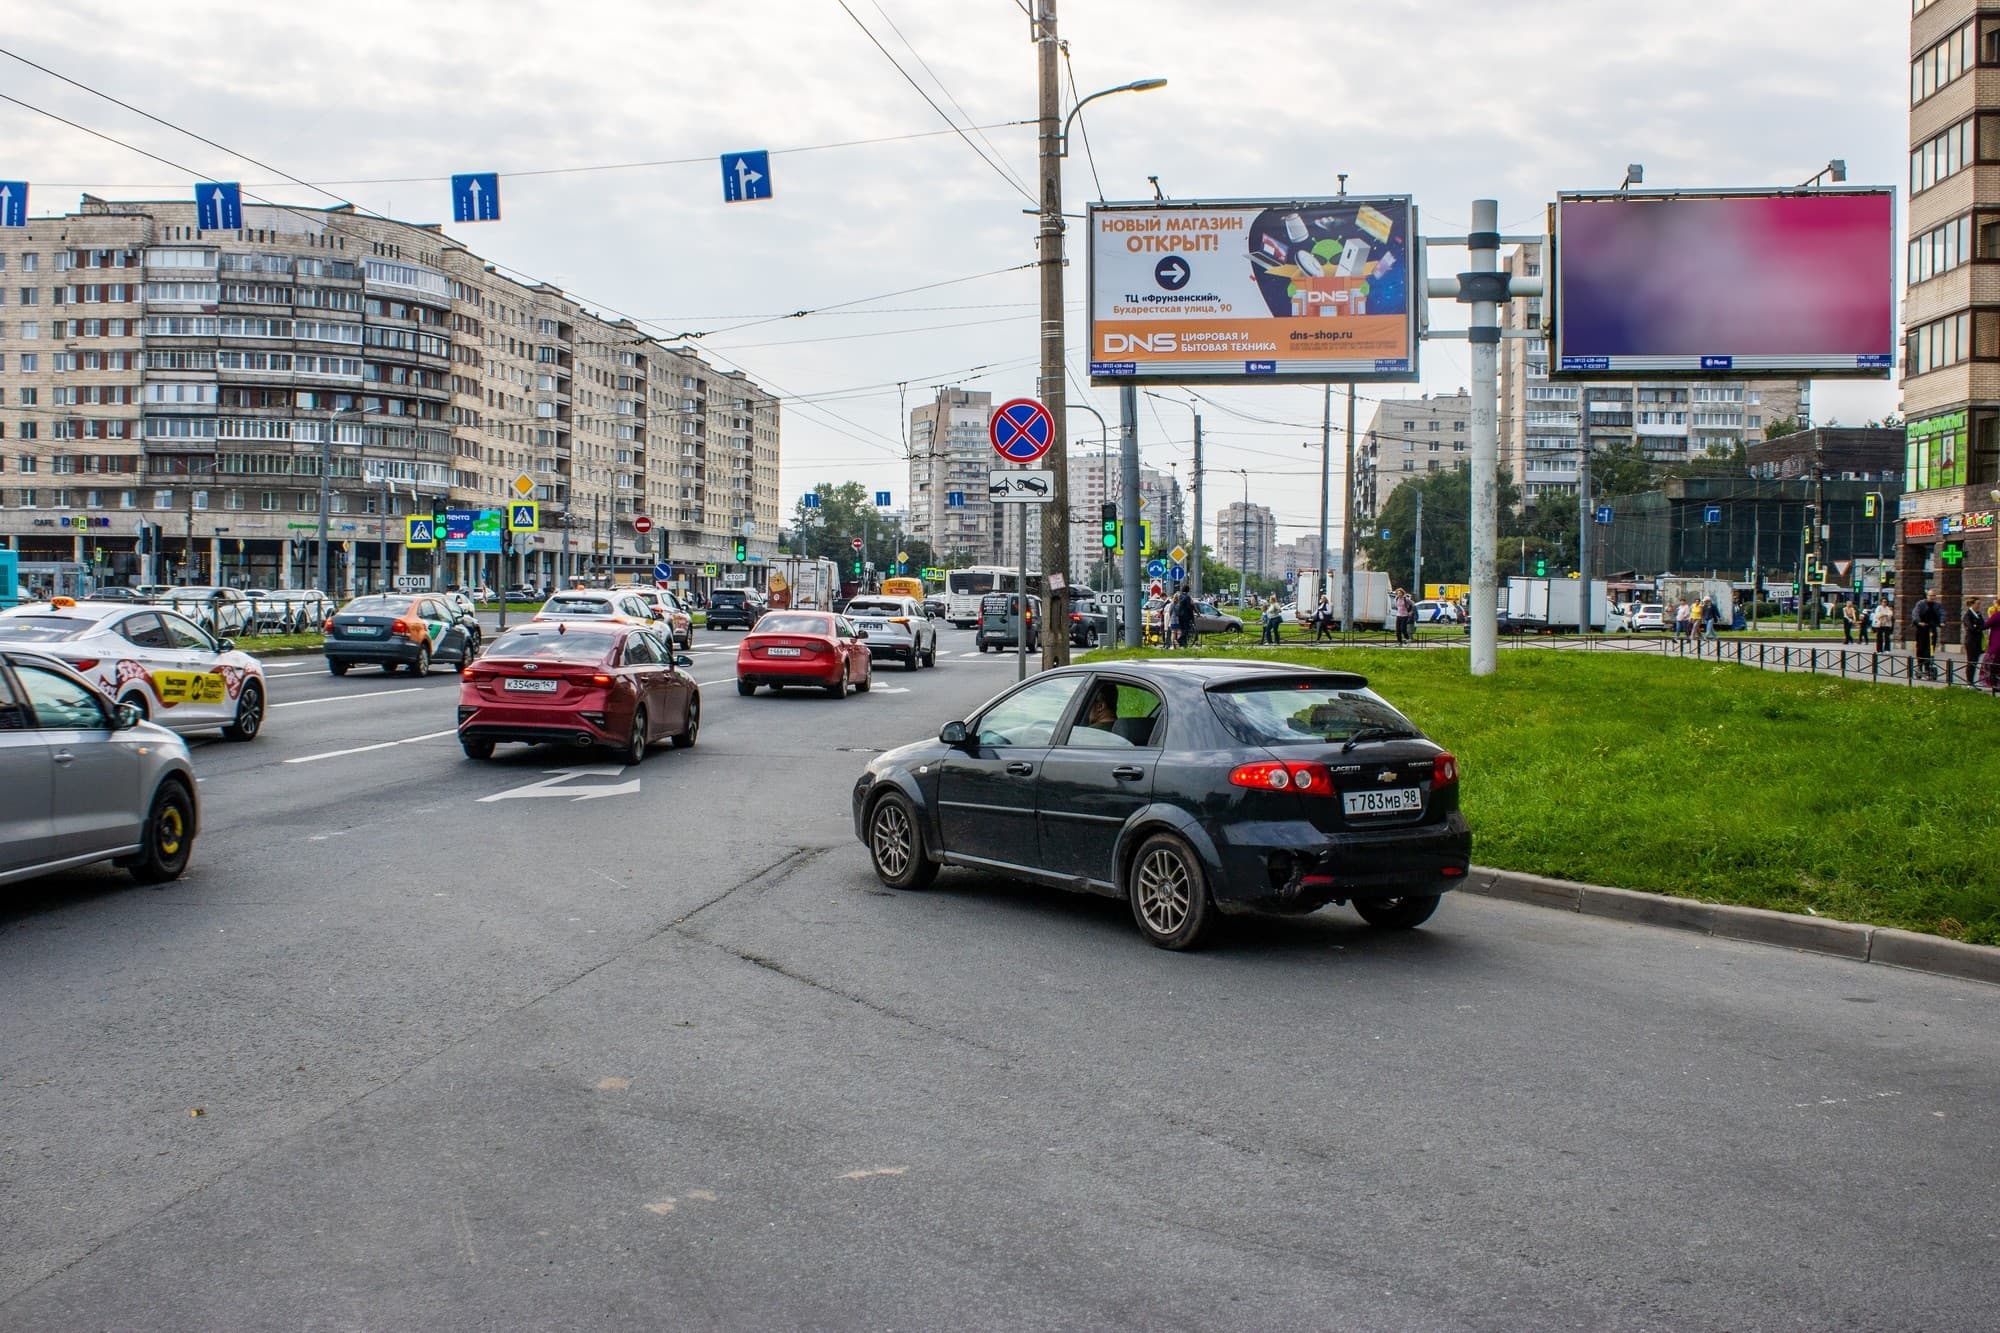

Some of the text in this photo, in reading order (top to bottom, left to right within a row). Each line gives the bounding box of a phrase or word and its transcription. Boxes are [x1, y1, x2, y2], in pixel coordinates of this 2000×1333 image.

[1102, 216, 1243, 232] НОВЫЙ МАГАЗИН
[1126, 234, 1219, 252] ОТКРЫТ!
[1125, 293, 1221, 304] ТЦ «Фрунзенский»,
[1308, 291, 1348, 302] DNS
[1113, 304, 1232, 316] Бухарестская улица, 90
[1181, 333, 1249, 342] ЦИФРОВАЯ И
[1290, 331, 1353, 340] dns-shop.ru
[1104, 333, 1177, 353] DNS
[1181, 342, 1277, 352] БЫТОВАЯ ТЕХНИКА
[398, 577, 426, 586] СТОП
[1100, 594, 1124, 604] СТО
[1404, 790, 1416, 803] 98
